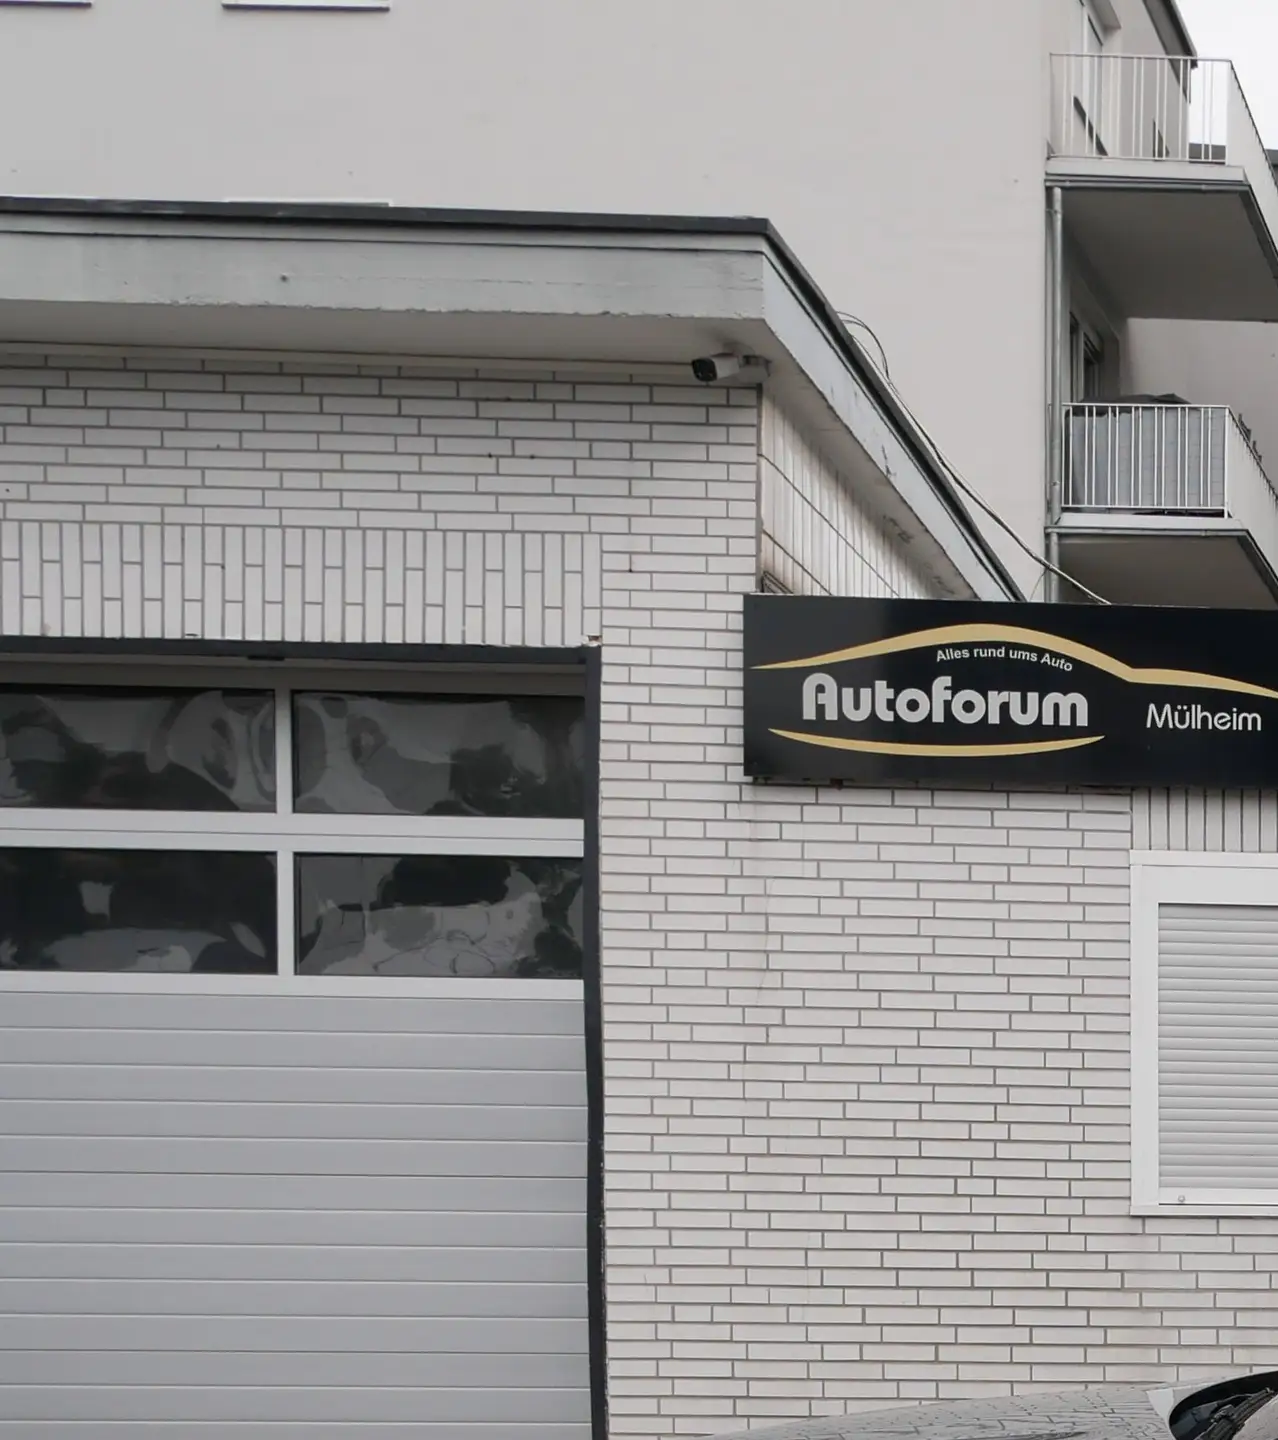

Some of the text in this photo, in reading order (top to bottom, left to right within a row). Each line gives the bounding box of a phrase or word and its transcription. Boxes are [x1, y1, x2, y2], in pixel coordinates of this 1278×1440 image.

[936, 646, 1073, 672] Alles rund ums Auto
[802, 672, 1089, 727] Autoforum
[1146, 703, 1262, 731] Mülheim
